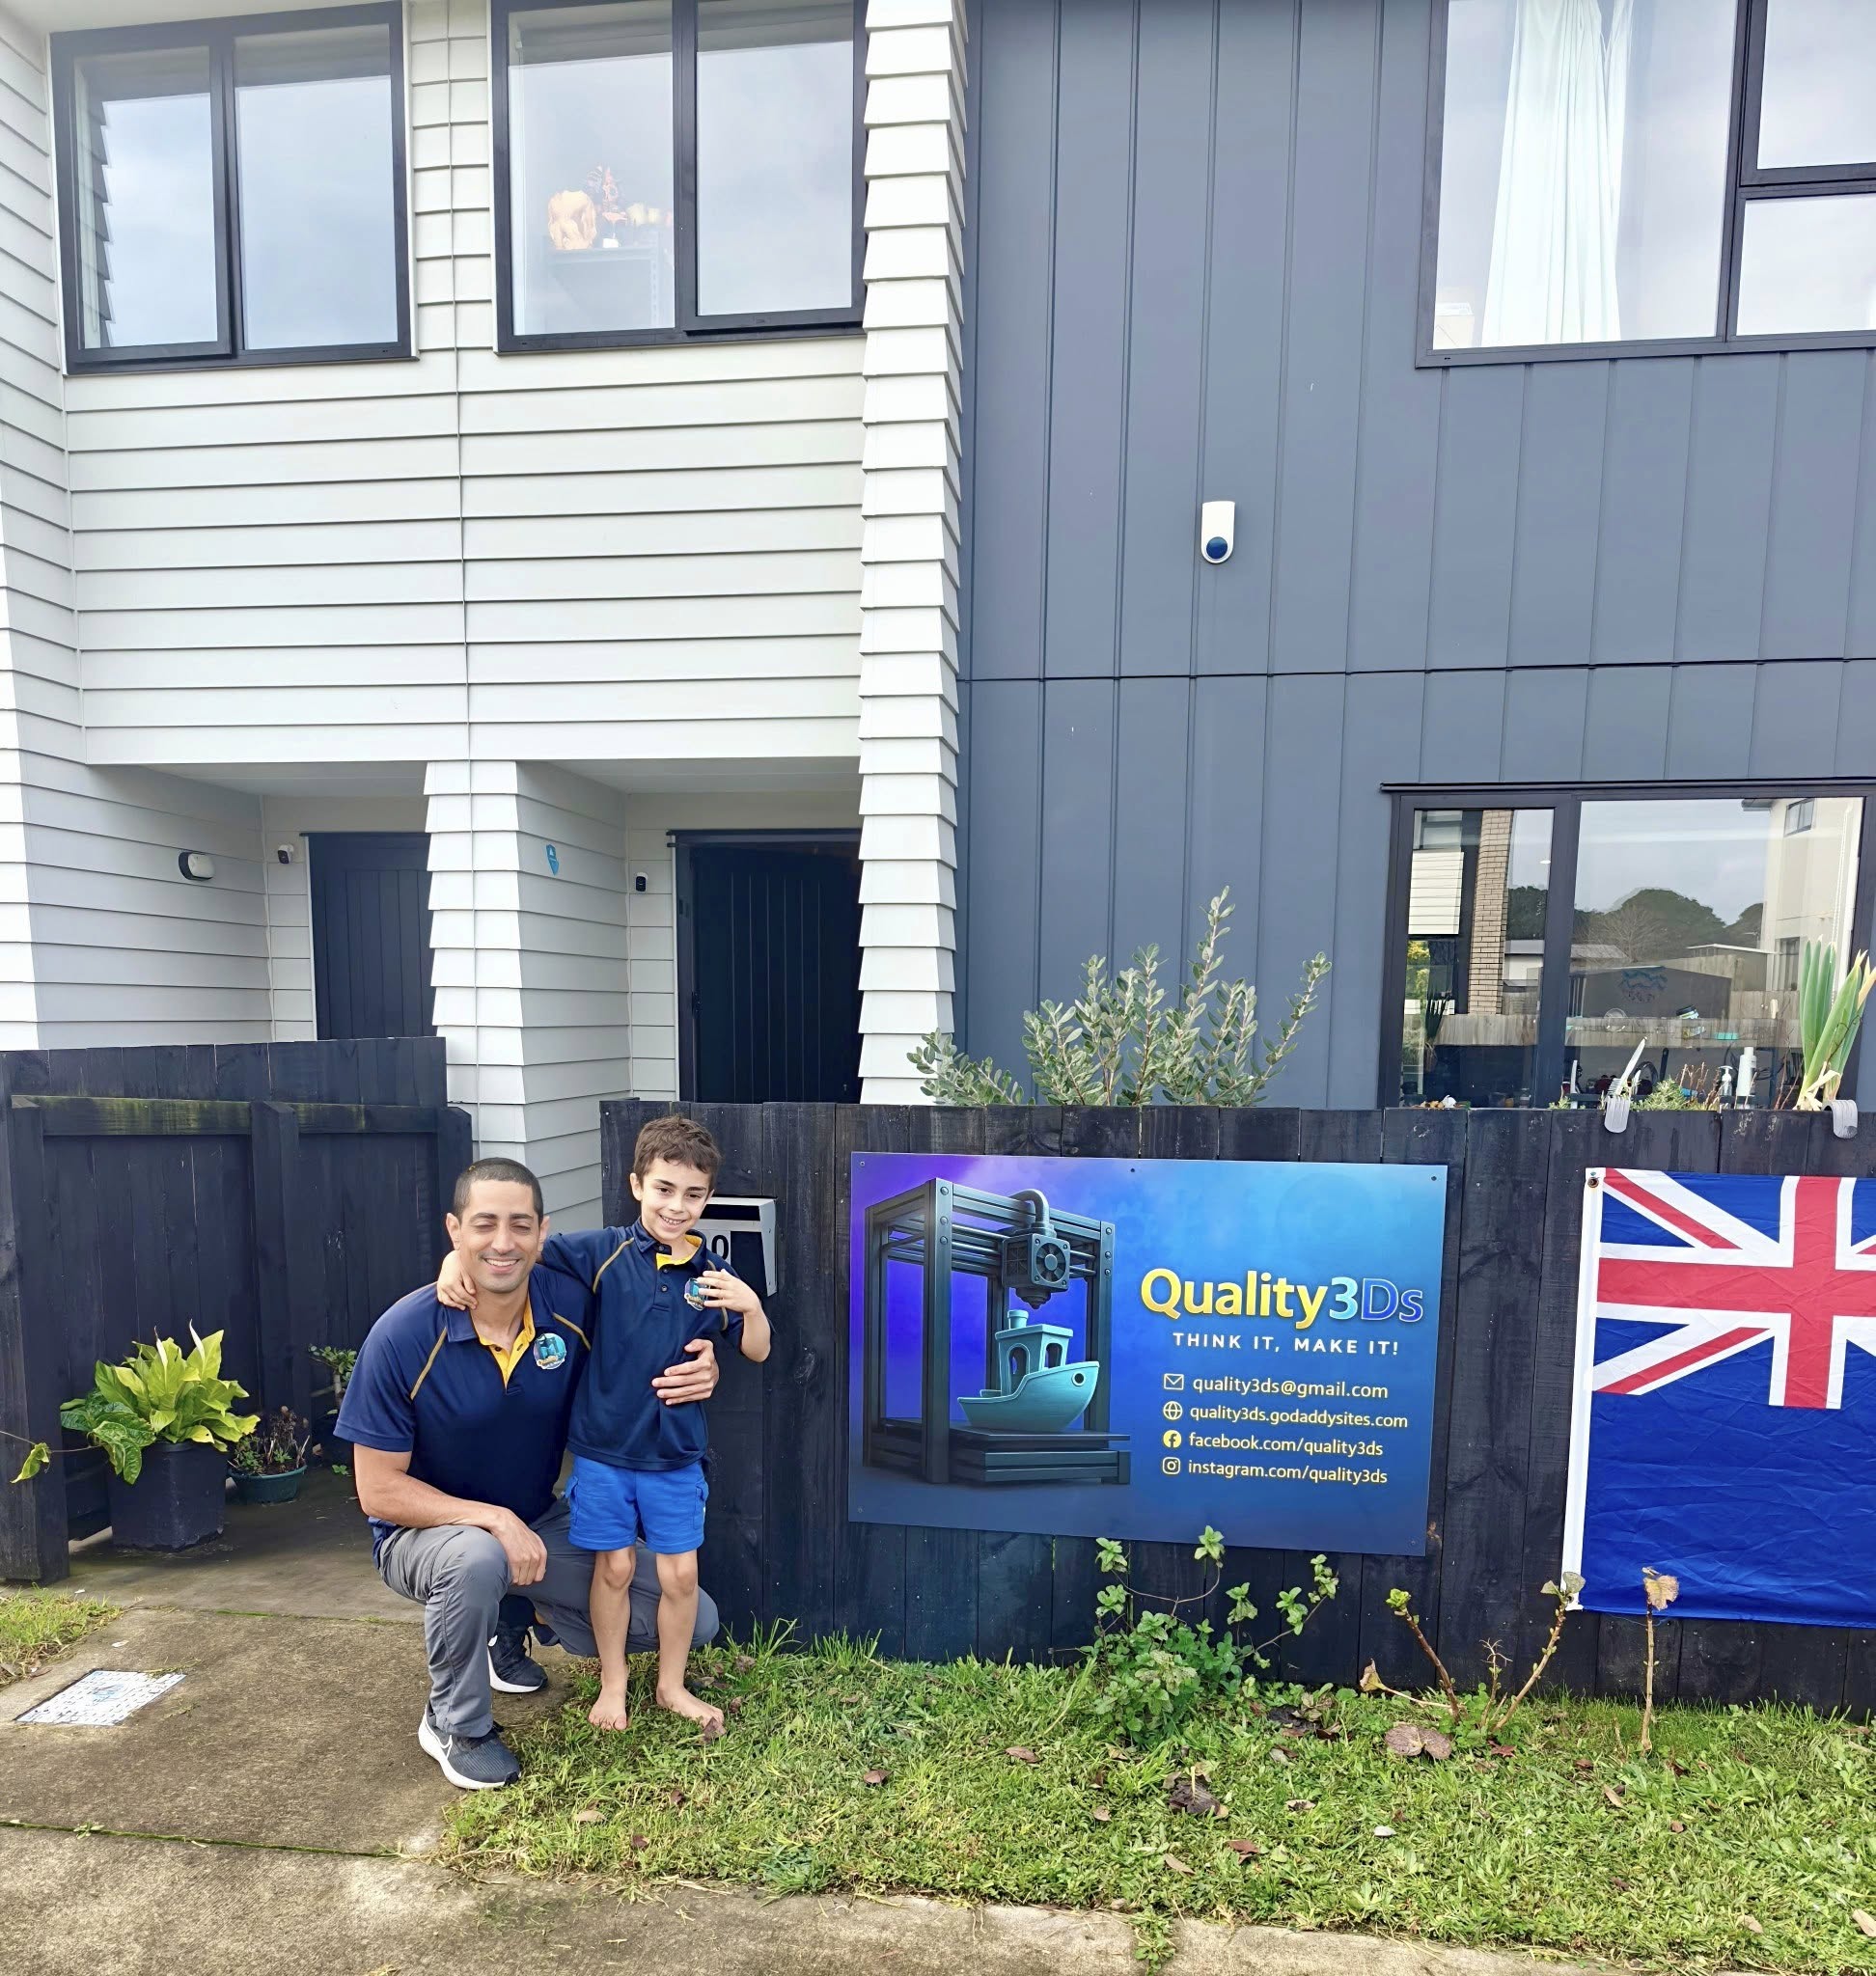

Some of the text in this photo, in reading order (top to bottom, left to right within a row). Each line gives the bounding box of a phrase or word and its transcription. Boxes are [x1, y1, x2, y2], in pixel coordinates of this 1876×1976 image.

[1141, 1268, 1423, 1330] Quality3Ds
[1172, 1331, 1398, 1356] THINK IT, MAKE IT!
[1193, 1376, 1389, 1399] quality3ds@gmail.com
[1190, 1405, 1409, 1428] quality3ds.godaddysites.com
[1189, 1432, 1384, 1457] facebook.com/quality3ds
[1188, 1459, 1389, 1485] instagram.com/quality3ds
